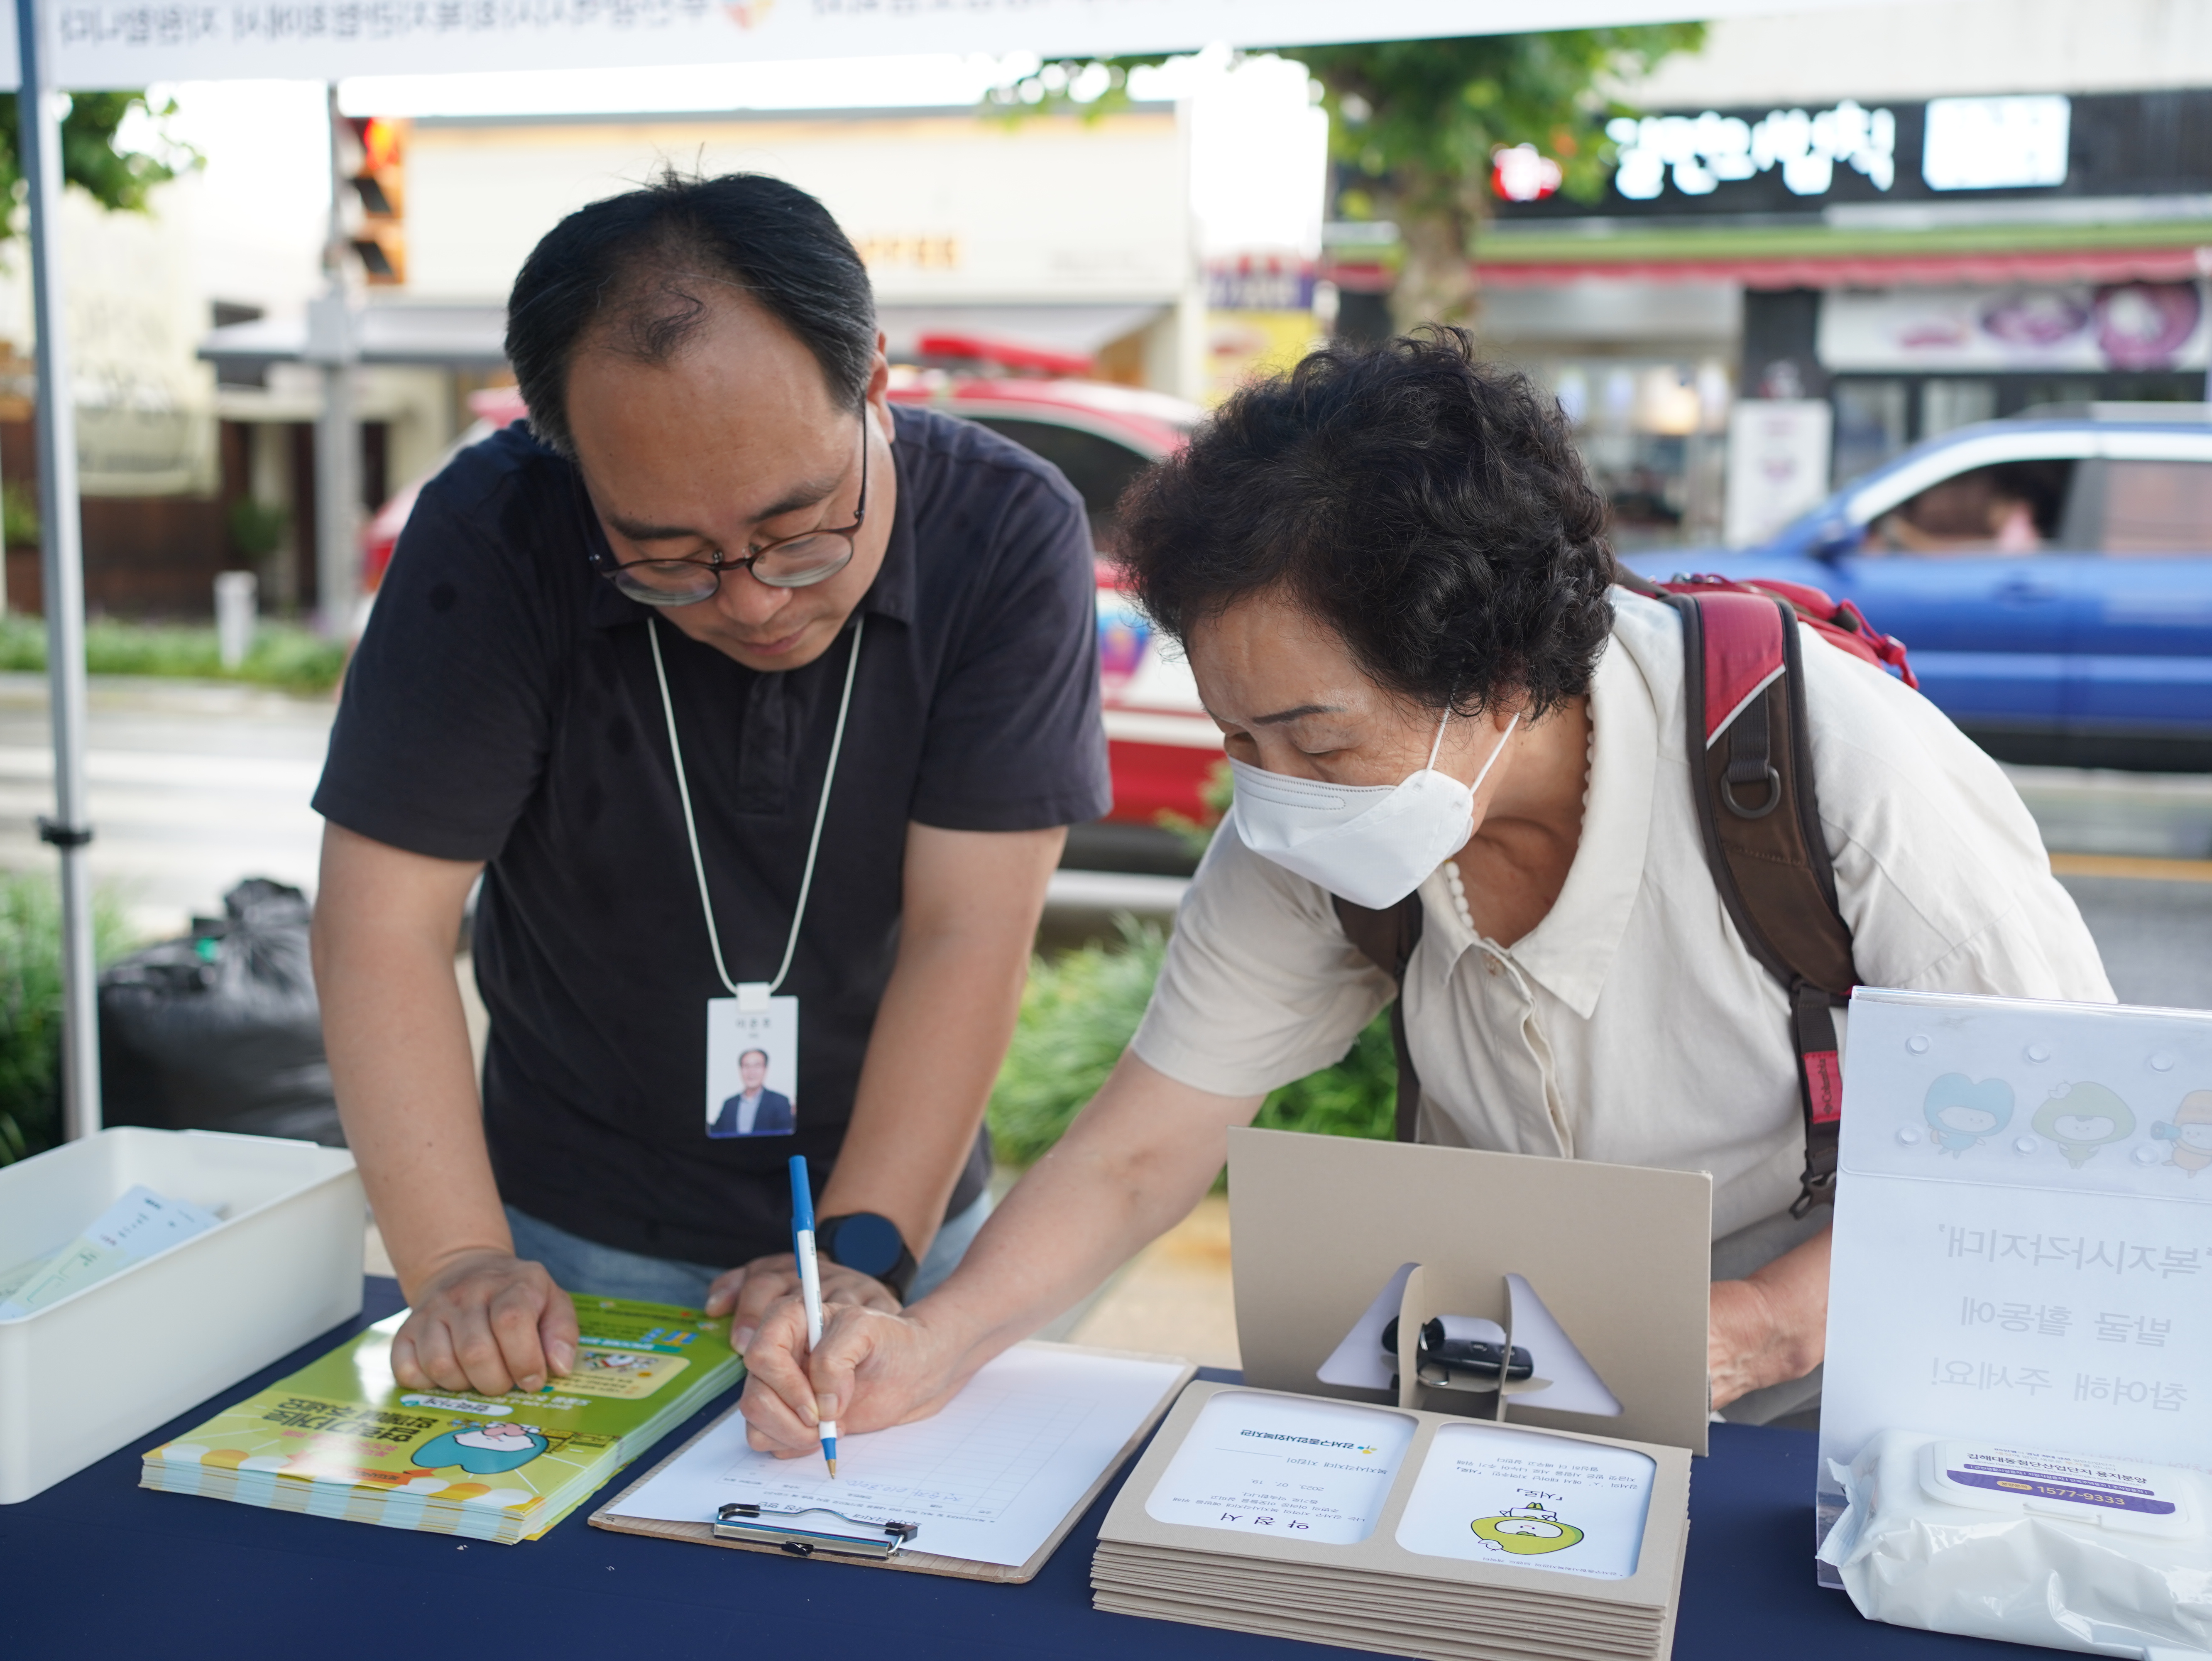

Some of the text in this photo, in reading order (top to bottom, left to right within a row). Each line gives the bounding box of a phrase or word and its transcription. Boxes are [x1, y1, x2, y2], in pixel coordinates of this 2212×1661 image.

[1817, 1058, 1832, 1102] Columbia
[277, 1398, 357, 1417] 주세요
[262, 1409, 421, 1442] 협력가게로
[1240, 1428, 1355, 1450] 강서구종합사회복지관
[1287, 1457, 1388, 1475] 복지사각지대 지킴이
[1492, 1471, 1527, 1479] 지역주민
[1967, 1453, 2092, 1475] 김해대동첨단산업단지
[2096, 1471, 2147, 1483] 용지분양
[1241, 1492, 1287, 1501] 약속합니다.
[1241, 1498, 1276, 1507] 이웃들을
[1516, 1488, 1563, 1501] 『서로』
[2036, 1486, 2125, 1505] 1577-9333
[1226, 1503, 1279, 1513] 복지사각지대
[1220, 1512, 1309, 1529] 약 정 서
